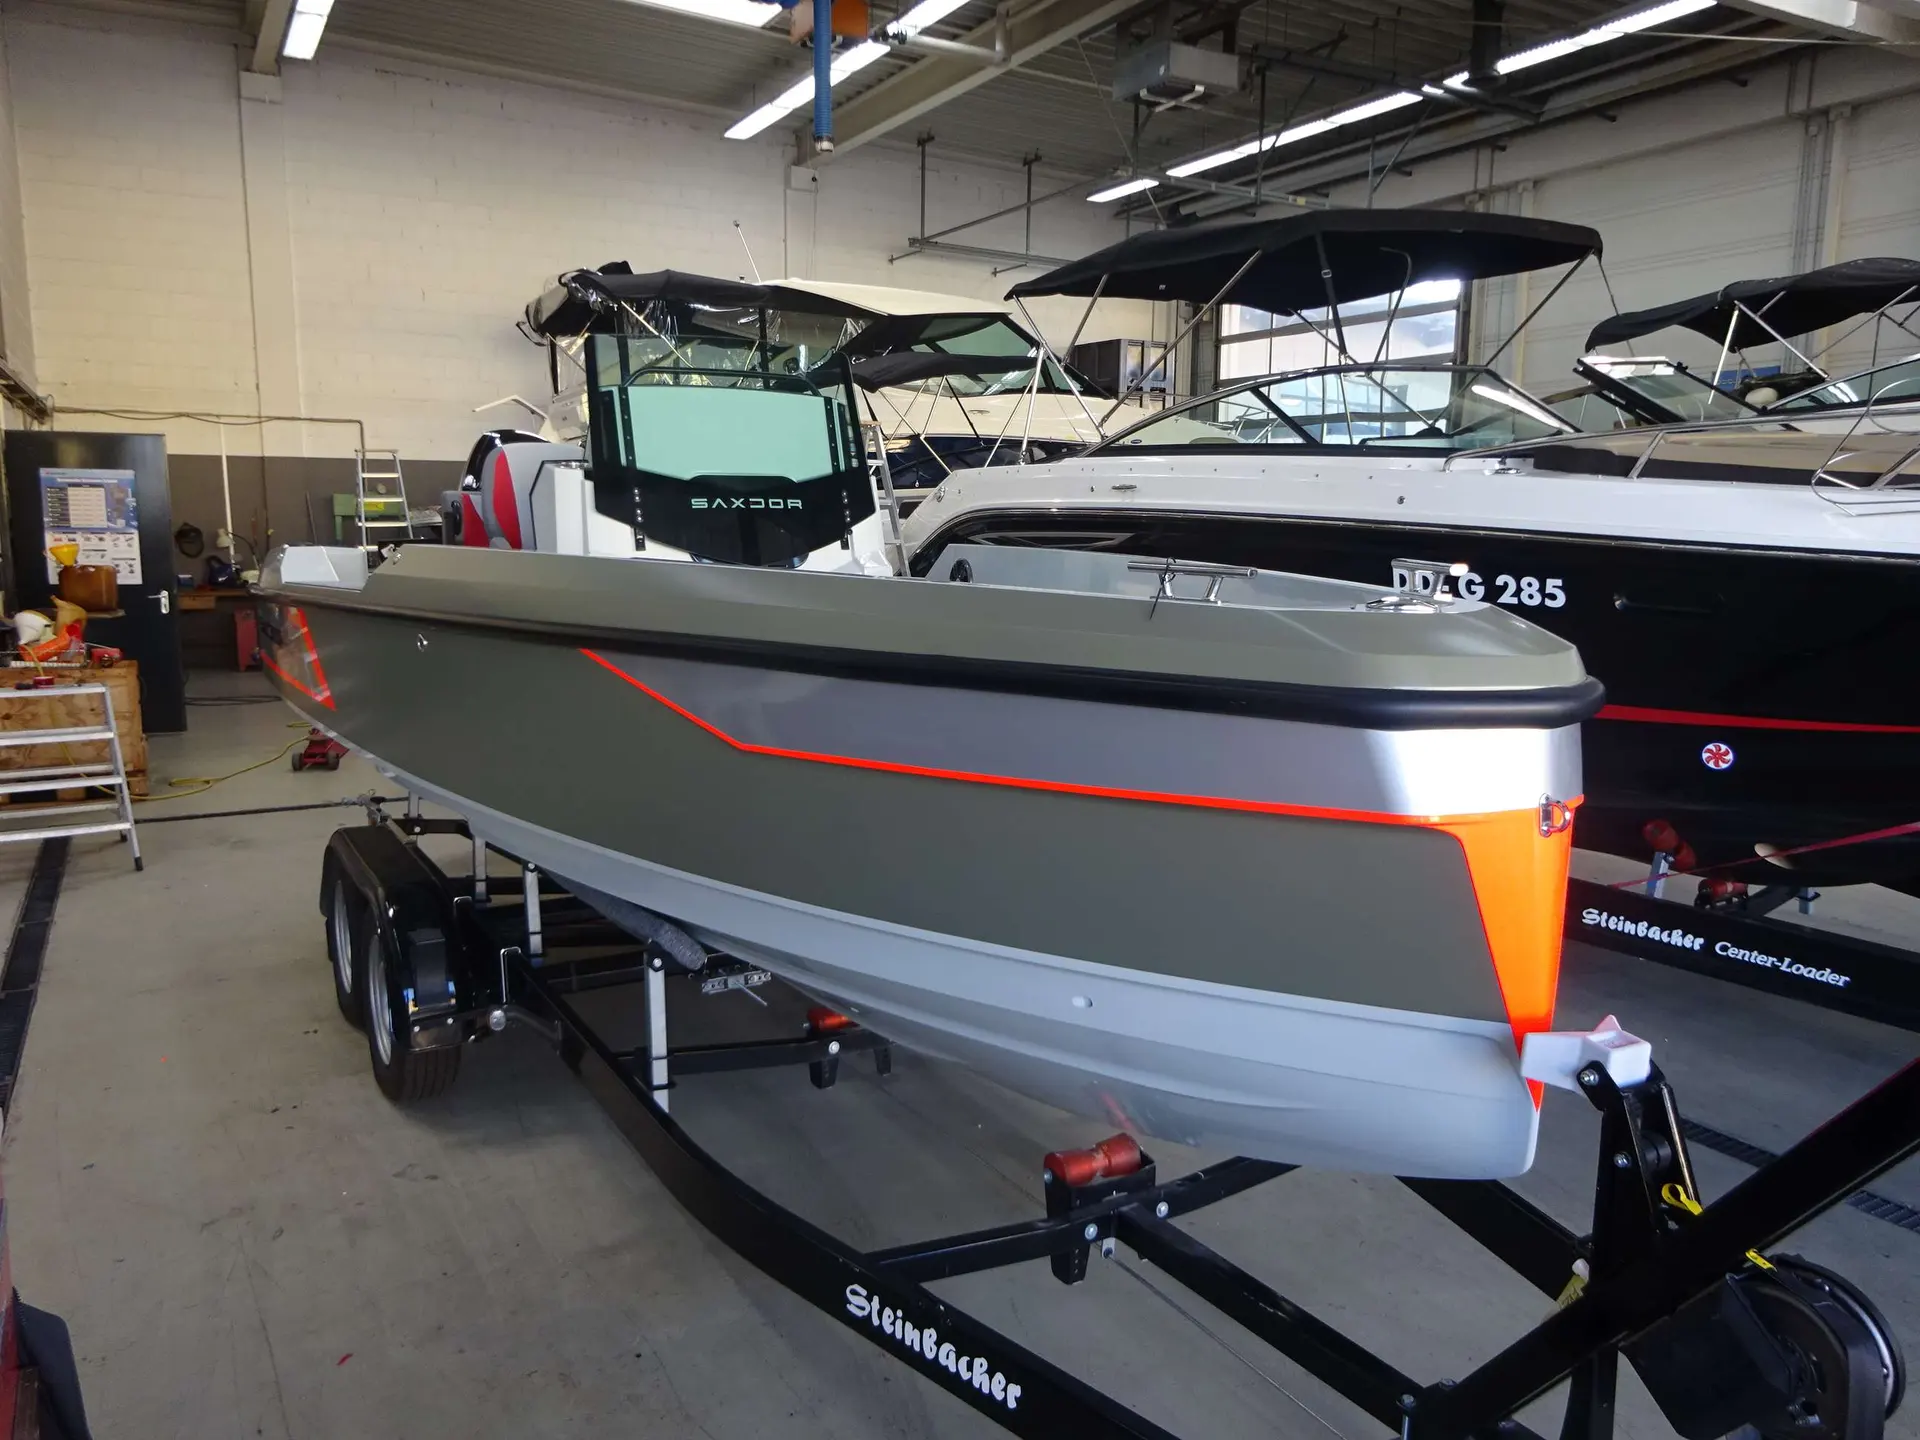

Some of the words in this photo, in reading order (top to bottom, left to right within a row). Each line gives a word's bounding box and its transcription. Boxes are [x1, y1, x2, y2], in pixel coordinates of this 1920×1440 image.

[690, 497, 803, 509] SAXDOR
[1495, 574, 1567, 608] 285
[1715, 942, 1850, 987] Center-Loader
